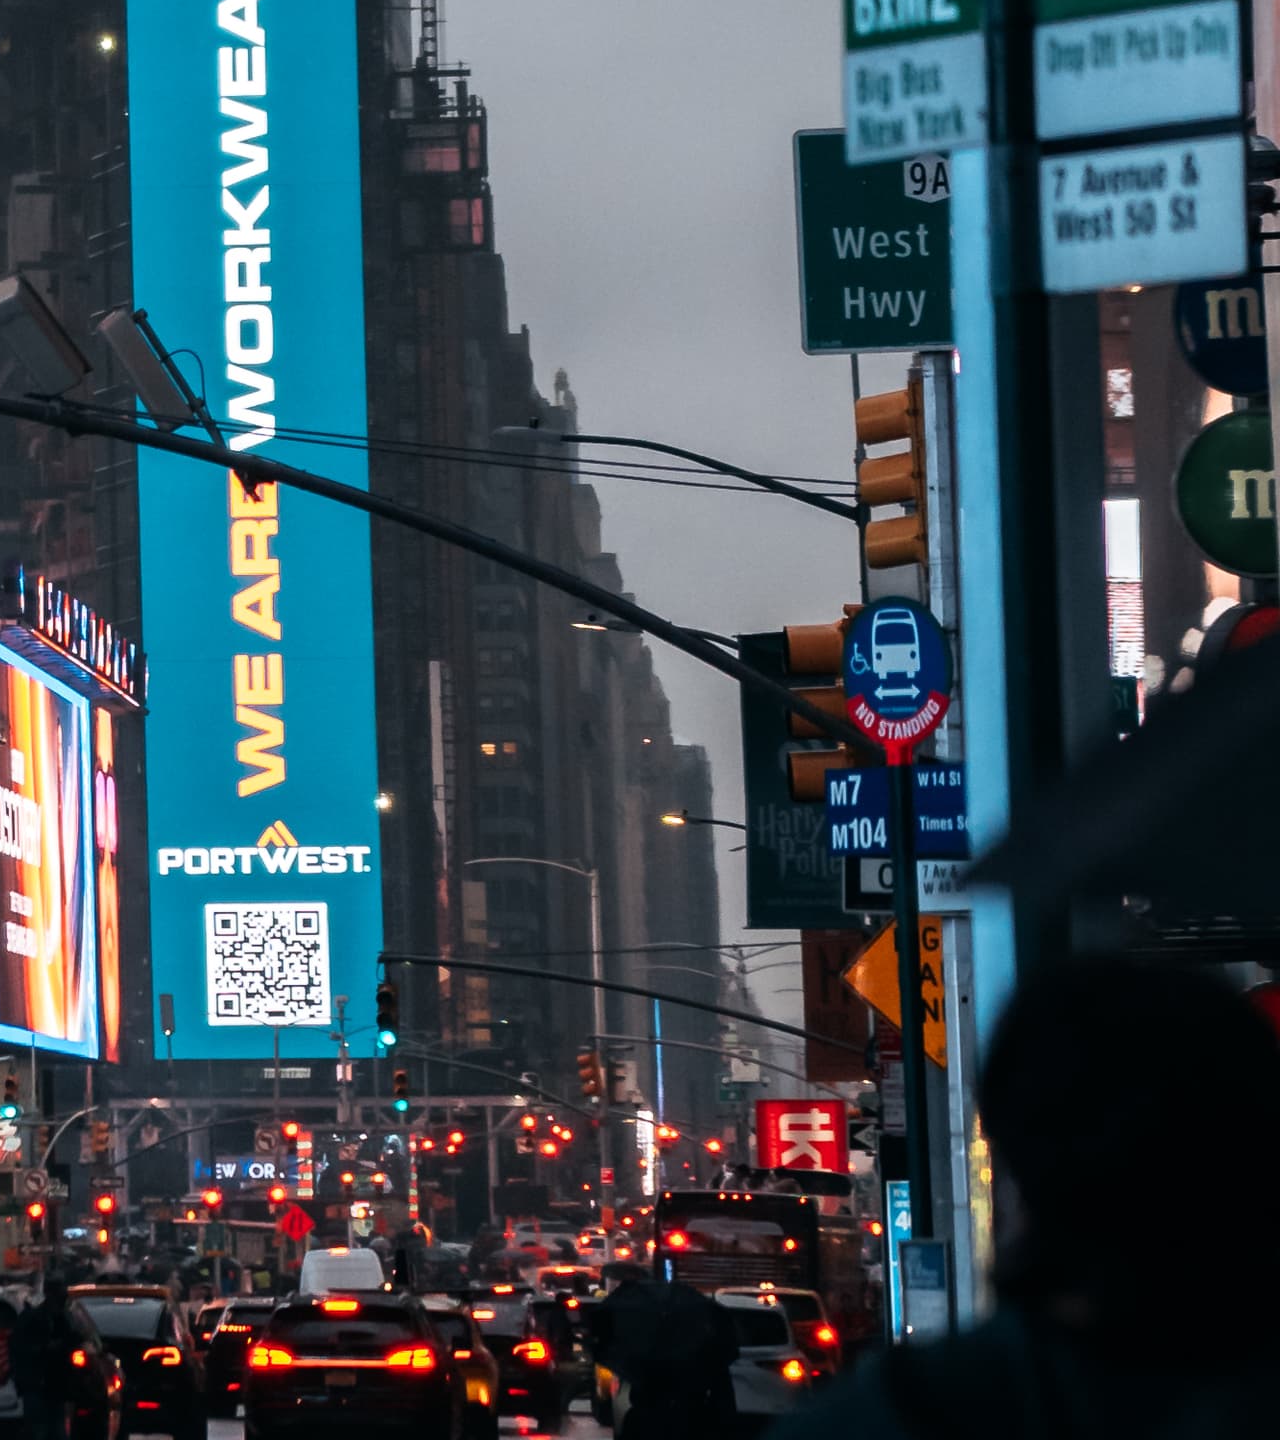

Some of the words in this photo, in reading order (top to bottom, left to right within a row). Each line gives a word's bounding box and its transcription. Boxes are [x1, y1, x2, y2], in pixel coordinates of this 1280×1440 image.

[1047, 34, 1085, 75] Drop
[1125, 24, 1160, 61] Pick
[1164, 25, 1187, 59] Up
[1194, 19, 1230, 58] Only
[855, 68, 893, 111] Big
[901, 59, 941, 97] Bus
[857, 114, 905, 148] New
[914, 105, 965, 138] York
[909, 160, 951, 196] 9A
[1052, 167, 1067, 198] 7
[1081, 158, 1167, 196] Avenue
[1180, 152, 1198, 186] &
[832, 222, 931, 259] West
[1054, 207, 1115, 243] West
[1125, 200, 1156, 237] 50
[1169, 195, 1197, 231] St
[842, 285, 927, 328] Hwy
[1205, 285, 1264, 340] m
[228, 468, 282, 641] ARE
[233, 653, 286, 799] WE
[854, 701, 876, 729] NO
[877, 698, 941, 741] STANDING
[830, 773, 862, 807] M7
[917, 771, 930, 788] W
[931, 770, 946, 787] 14
[948, 769, 962, 787] St
[754, 802, 826, 850] Harry
[832, 816, 888, 851] M104
[919, 815, 954, 833] Times
